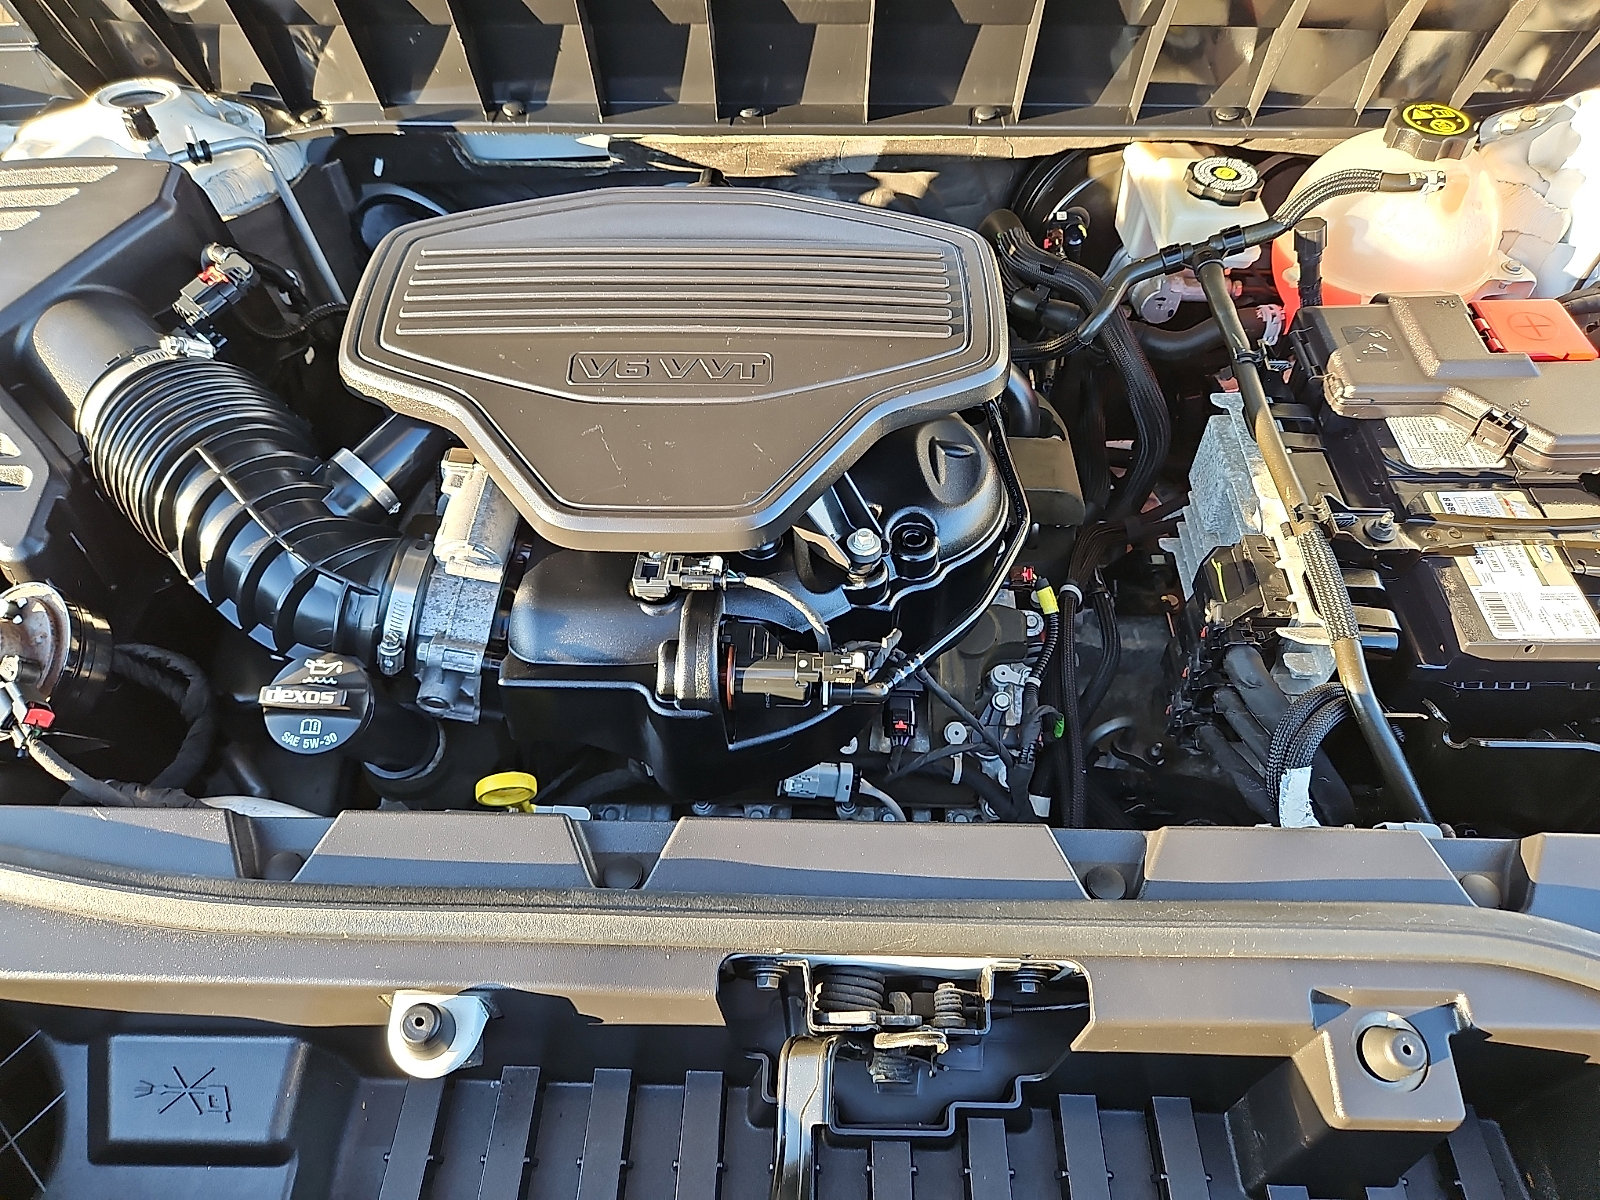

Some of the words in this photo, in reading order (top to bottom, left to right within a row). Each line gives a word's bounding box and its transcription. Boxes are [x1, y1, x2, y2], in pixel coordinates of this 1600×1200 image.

[577, 357, 650, 379] V6
[659, 357, 767, 380] VVT
[264, 686, 338, 704] dexos
[281, 731, 301, 747] SAE
[302, 732, 338, 749] 5W-30
